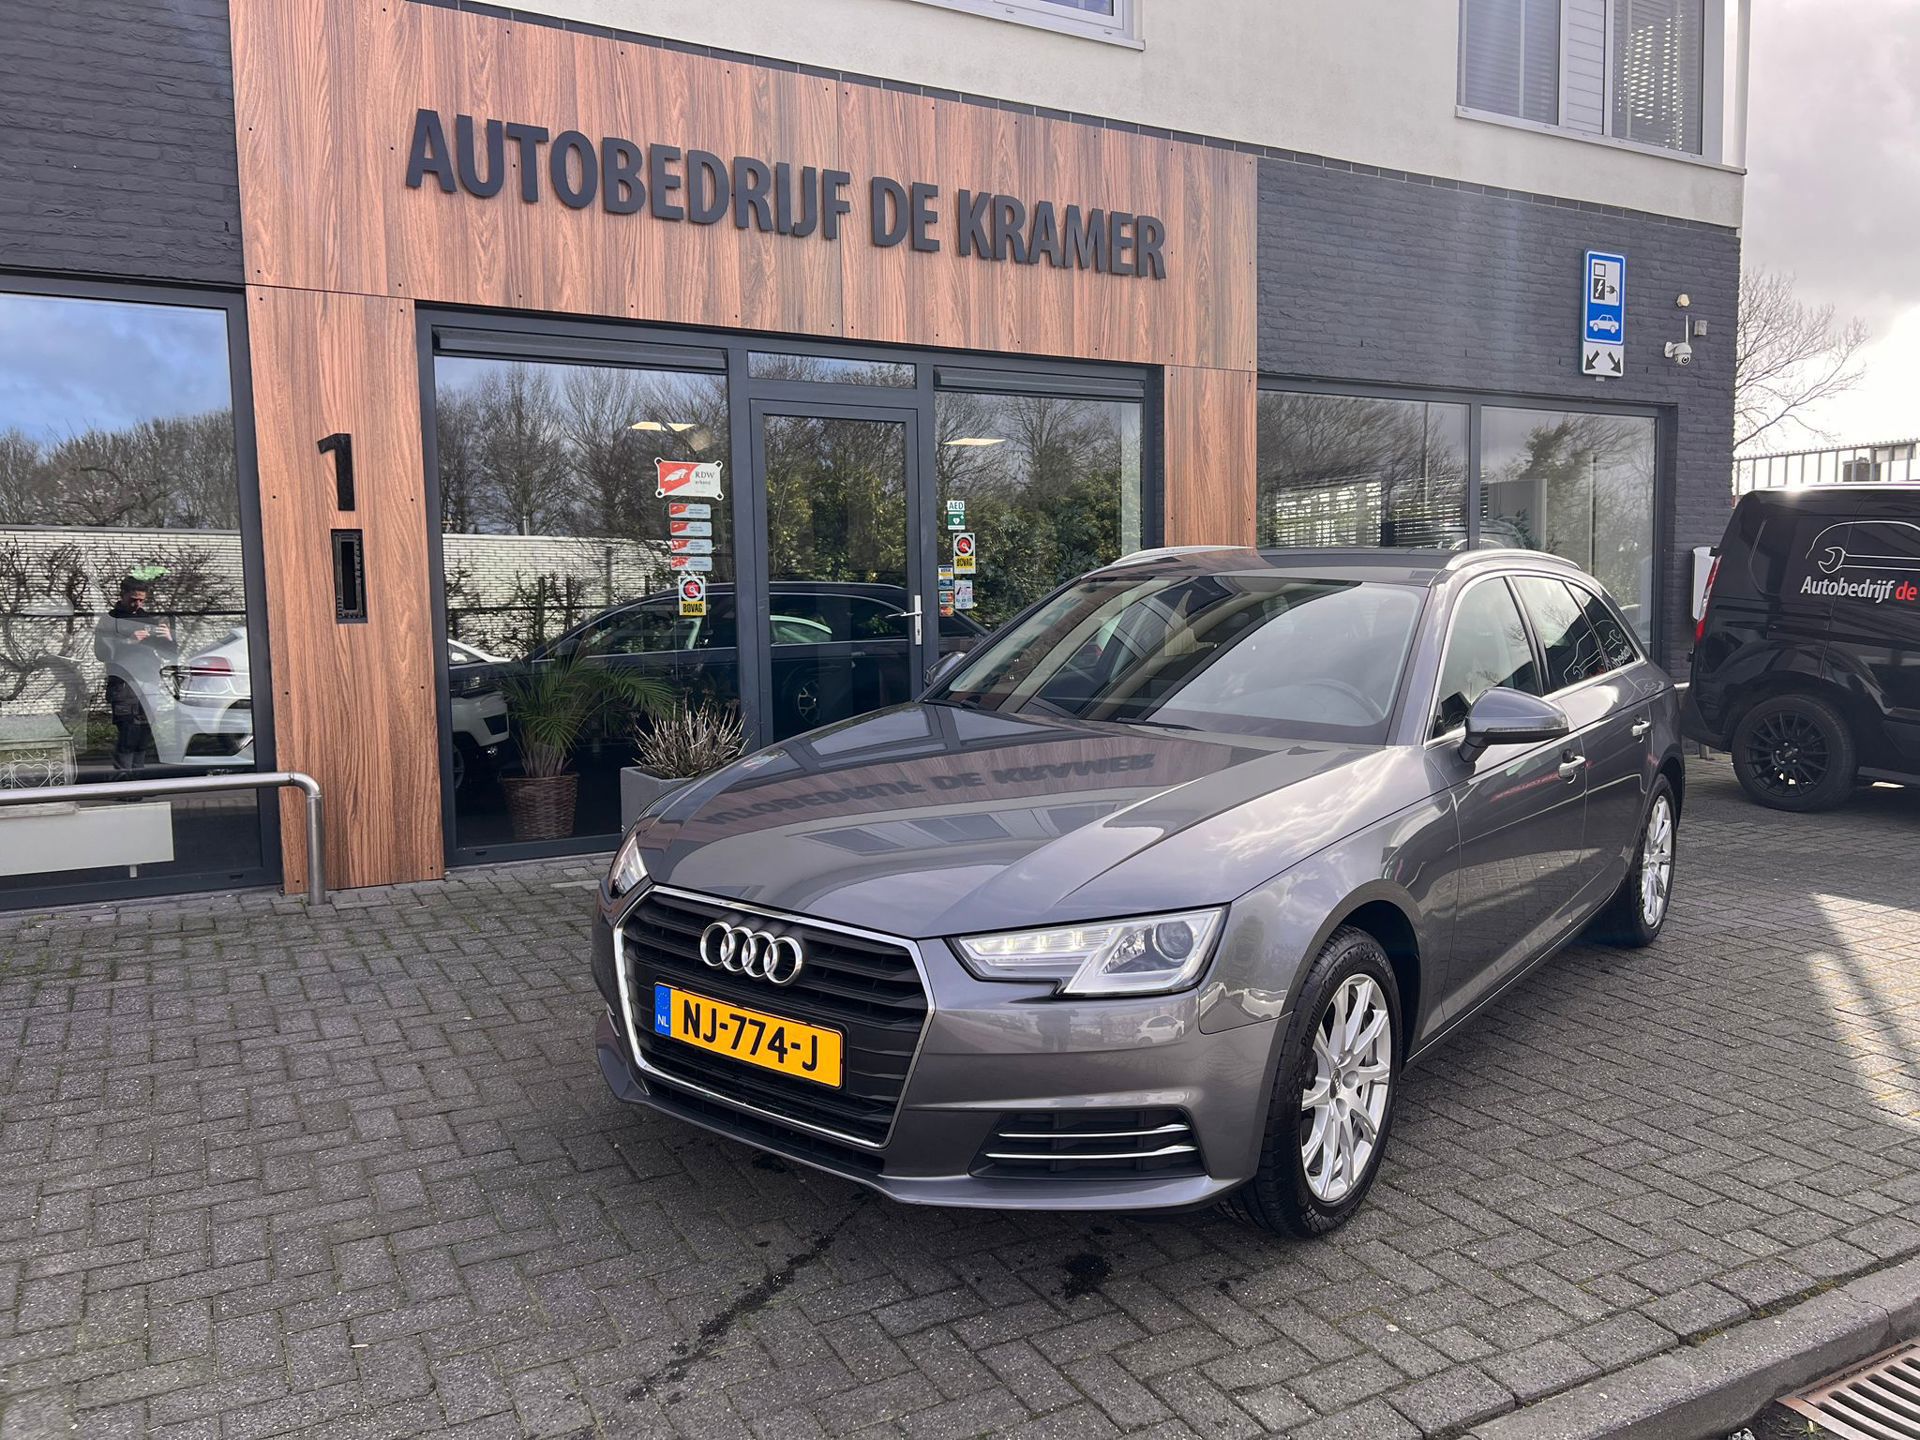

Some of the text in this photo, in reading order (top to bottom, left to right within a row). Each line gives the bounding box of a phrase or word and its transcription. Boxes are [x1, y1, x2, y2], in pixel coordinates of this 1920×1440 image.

[406, 108, 1167, 281] AUTOBEDRIJF DE KRAMER
[316, 433, 356, 512] 1
[695, 471, 715, 479] RDW
[948, 501, 964, 510] AED
[1800, 575, 1918, 604] Autobedrijf de
[682, 603, 703, 613] BOVAG
[657, 1013, 670, 1028] NL
[682, 999, 818, 1072] NJ-774-J
